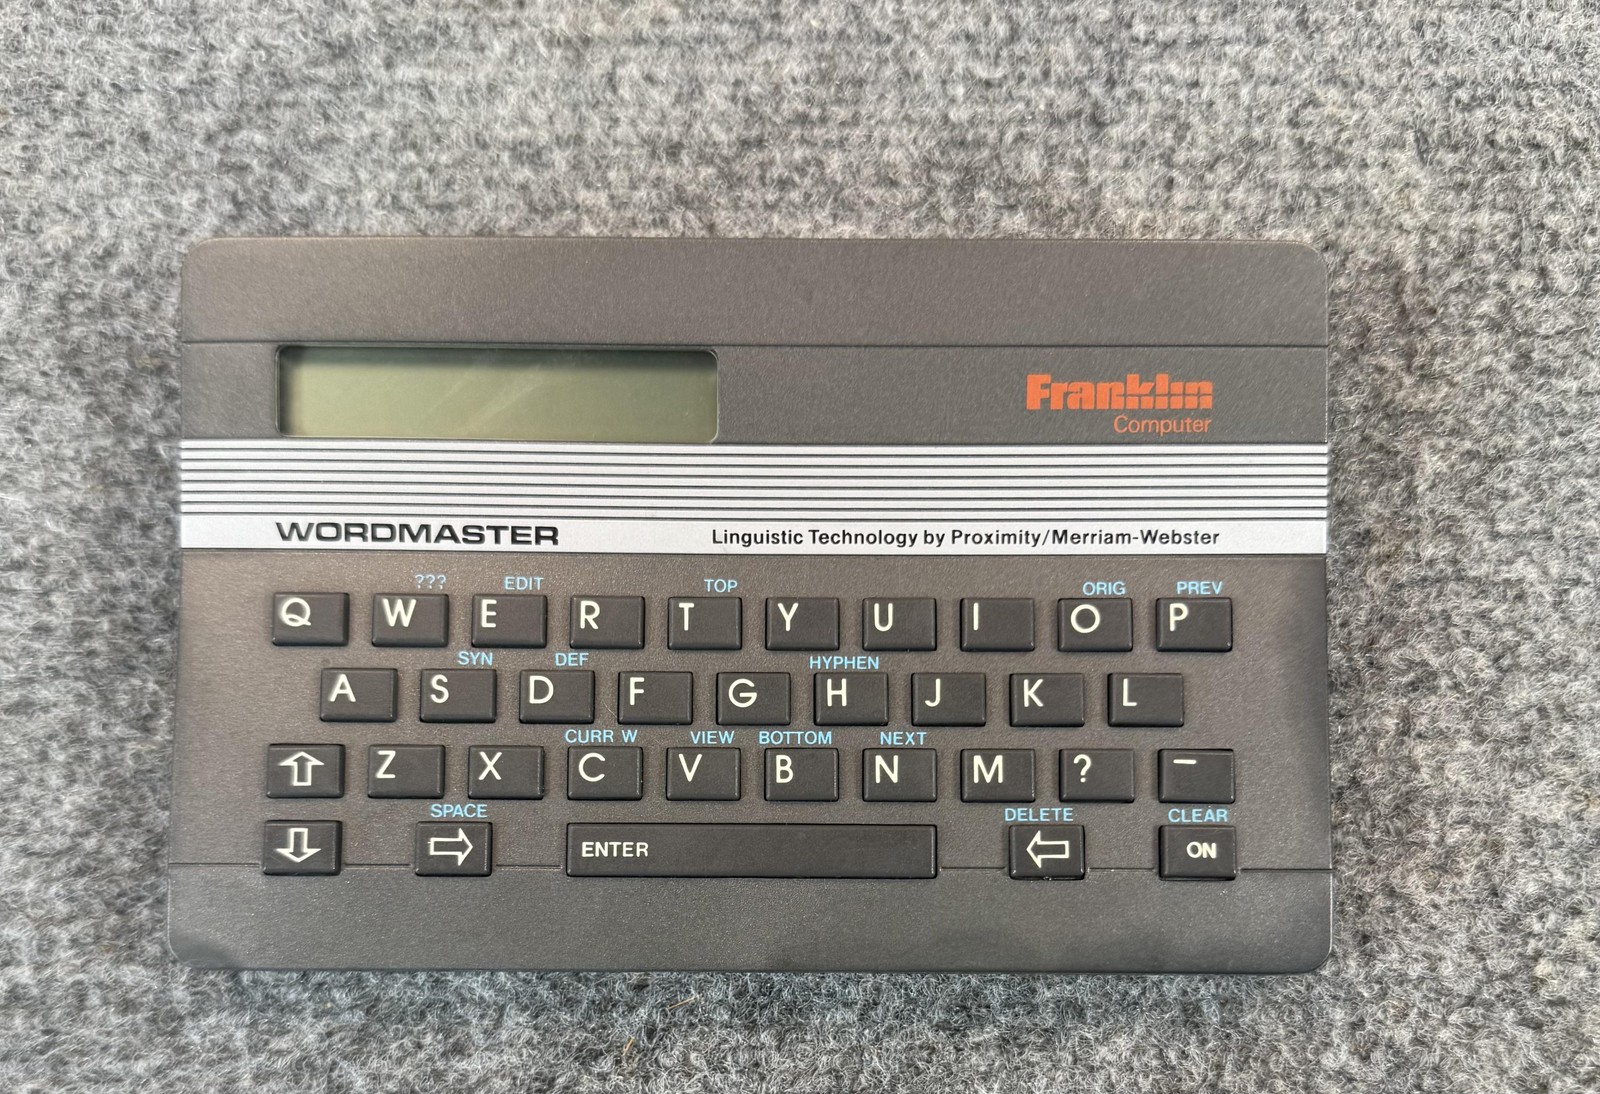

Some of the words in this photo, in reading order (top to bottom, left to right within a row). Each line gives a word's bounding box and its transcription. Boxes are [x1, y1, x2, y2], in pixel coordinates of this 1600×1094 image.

[1026, 373, 1213, 410] Franklin
[1113, 416, 1209, 434] Computer
[276, 523, 558, 545] WORDMASTER
[713, 530, 803, 547] Linguistic
[809, 530, 917, 547] Technology
[924, 530, 945, 547] by
[952, 530, 1219, 547] Proximity/Merriam-Webster
[505, 577, 544, 590] EDIT
[704, 579, 738, 593] TOP
[1083, 581, 1126, 596] ORIG
[1176, 581, 1222, 595] PREV
[281, 598, 311, 628] Q
[382, 599, 416, 628] W
[481, 599, 497, 629] E
[580, 600, 600, 629] R
[679, 602, 694, 631] T
[778, 603, 798, 631] Y
[874, 603, 893, 631] U
[973, 602, 979, 630] I
[1071, 604, 1100, 633] O
[1170, 603, 1189, 631] P
[457, 652, 493, 666] SYN
[555, 653, 589, 666] DEF
[809, 656, 879, 670] HYPHEN
[330, 674, 356, 703] A
[430, 674, 449, 703] S
[529, 675, 553, 704] D
[630, 677, 644, 705] F
[729, 679, 757, 707] G
[827, 678, 847, 706] H
[925, 678, 940, 707] J
[1024, 679, 1043, 707] K
[1123, 678, 1137, 706] L
[565, 730, 613, 744] CURR
[621, 730, 637, 744] W
[691, 731, 734, 744] VIEW
[759, 731, 832, 745] BOTTOM
[880, 731, 926, 745] NEXT
[375, 748, 396, 778] Z
[478, 751, 503, 780] X
[579, 753, 605, 782] C
[679, 754, 702, 782] V
[776, 755, 793, 783] B
[875, 755, 898, 783] N
[974, 755, 1003, 783] M
[1074, 754, 1091, 782] ?
[431, 804, 487, 818] SPACE
[1005, 808, 1073, 822] DELETE
[1168, 809, 1228, 822] CLEAR
[582, 842, 648, 857] ENTER
[1187, 842, 1217, 858] ON
